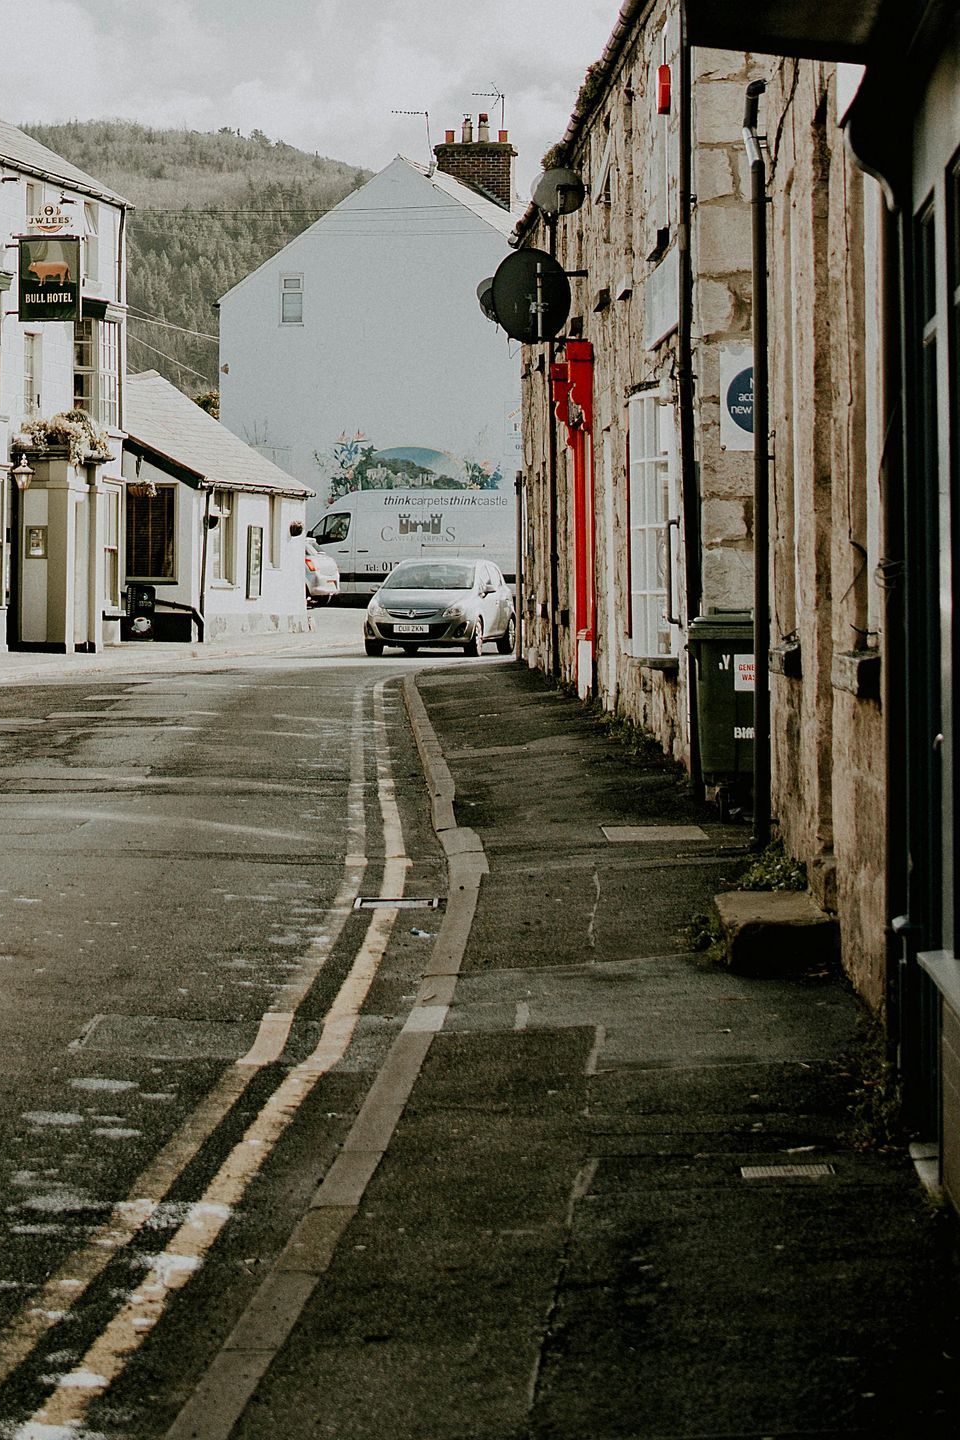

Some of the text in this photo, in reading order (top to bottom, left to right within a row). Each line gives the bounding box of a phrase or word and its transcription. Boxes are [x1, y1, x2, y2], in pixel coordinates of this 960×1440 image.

[25, 292, 73, 303] BULL HOTEL
[730, 405, 752, 414] new
